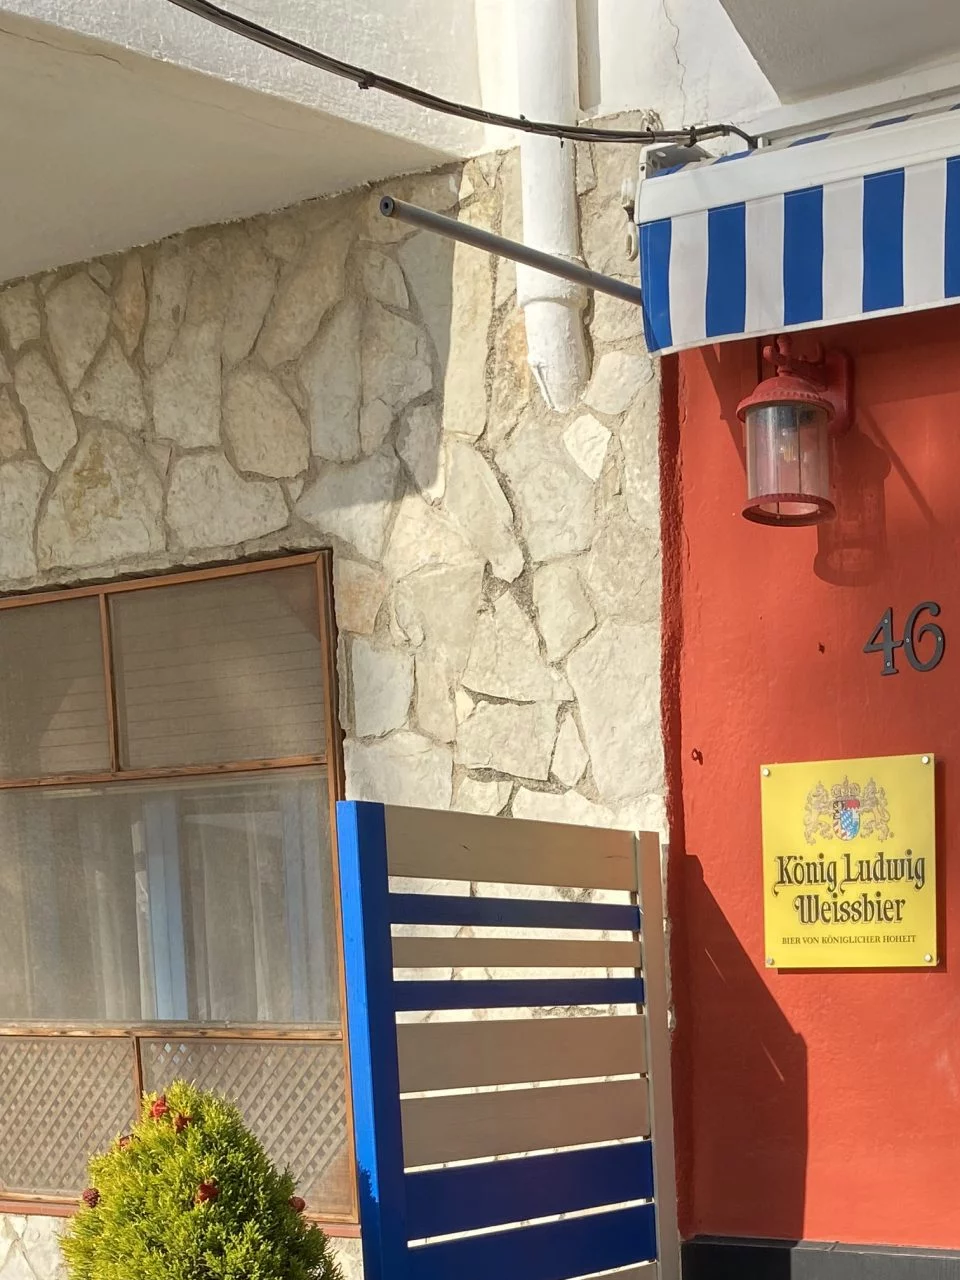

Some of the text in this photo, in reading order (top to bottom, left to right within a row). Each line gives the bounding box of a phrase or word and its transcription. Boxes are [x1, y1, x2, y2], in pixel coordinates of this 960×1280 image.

[863, 601, 946, 676] 46
[773, 849, 926, 896] König Ludwig
[793, 890, 906, 924] Weissbier
[782, 934, 917, 945] BIER VON KÖNIGLICHER HOHEIT
